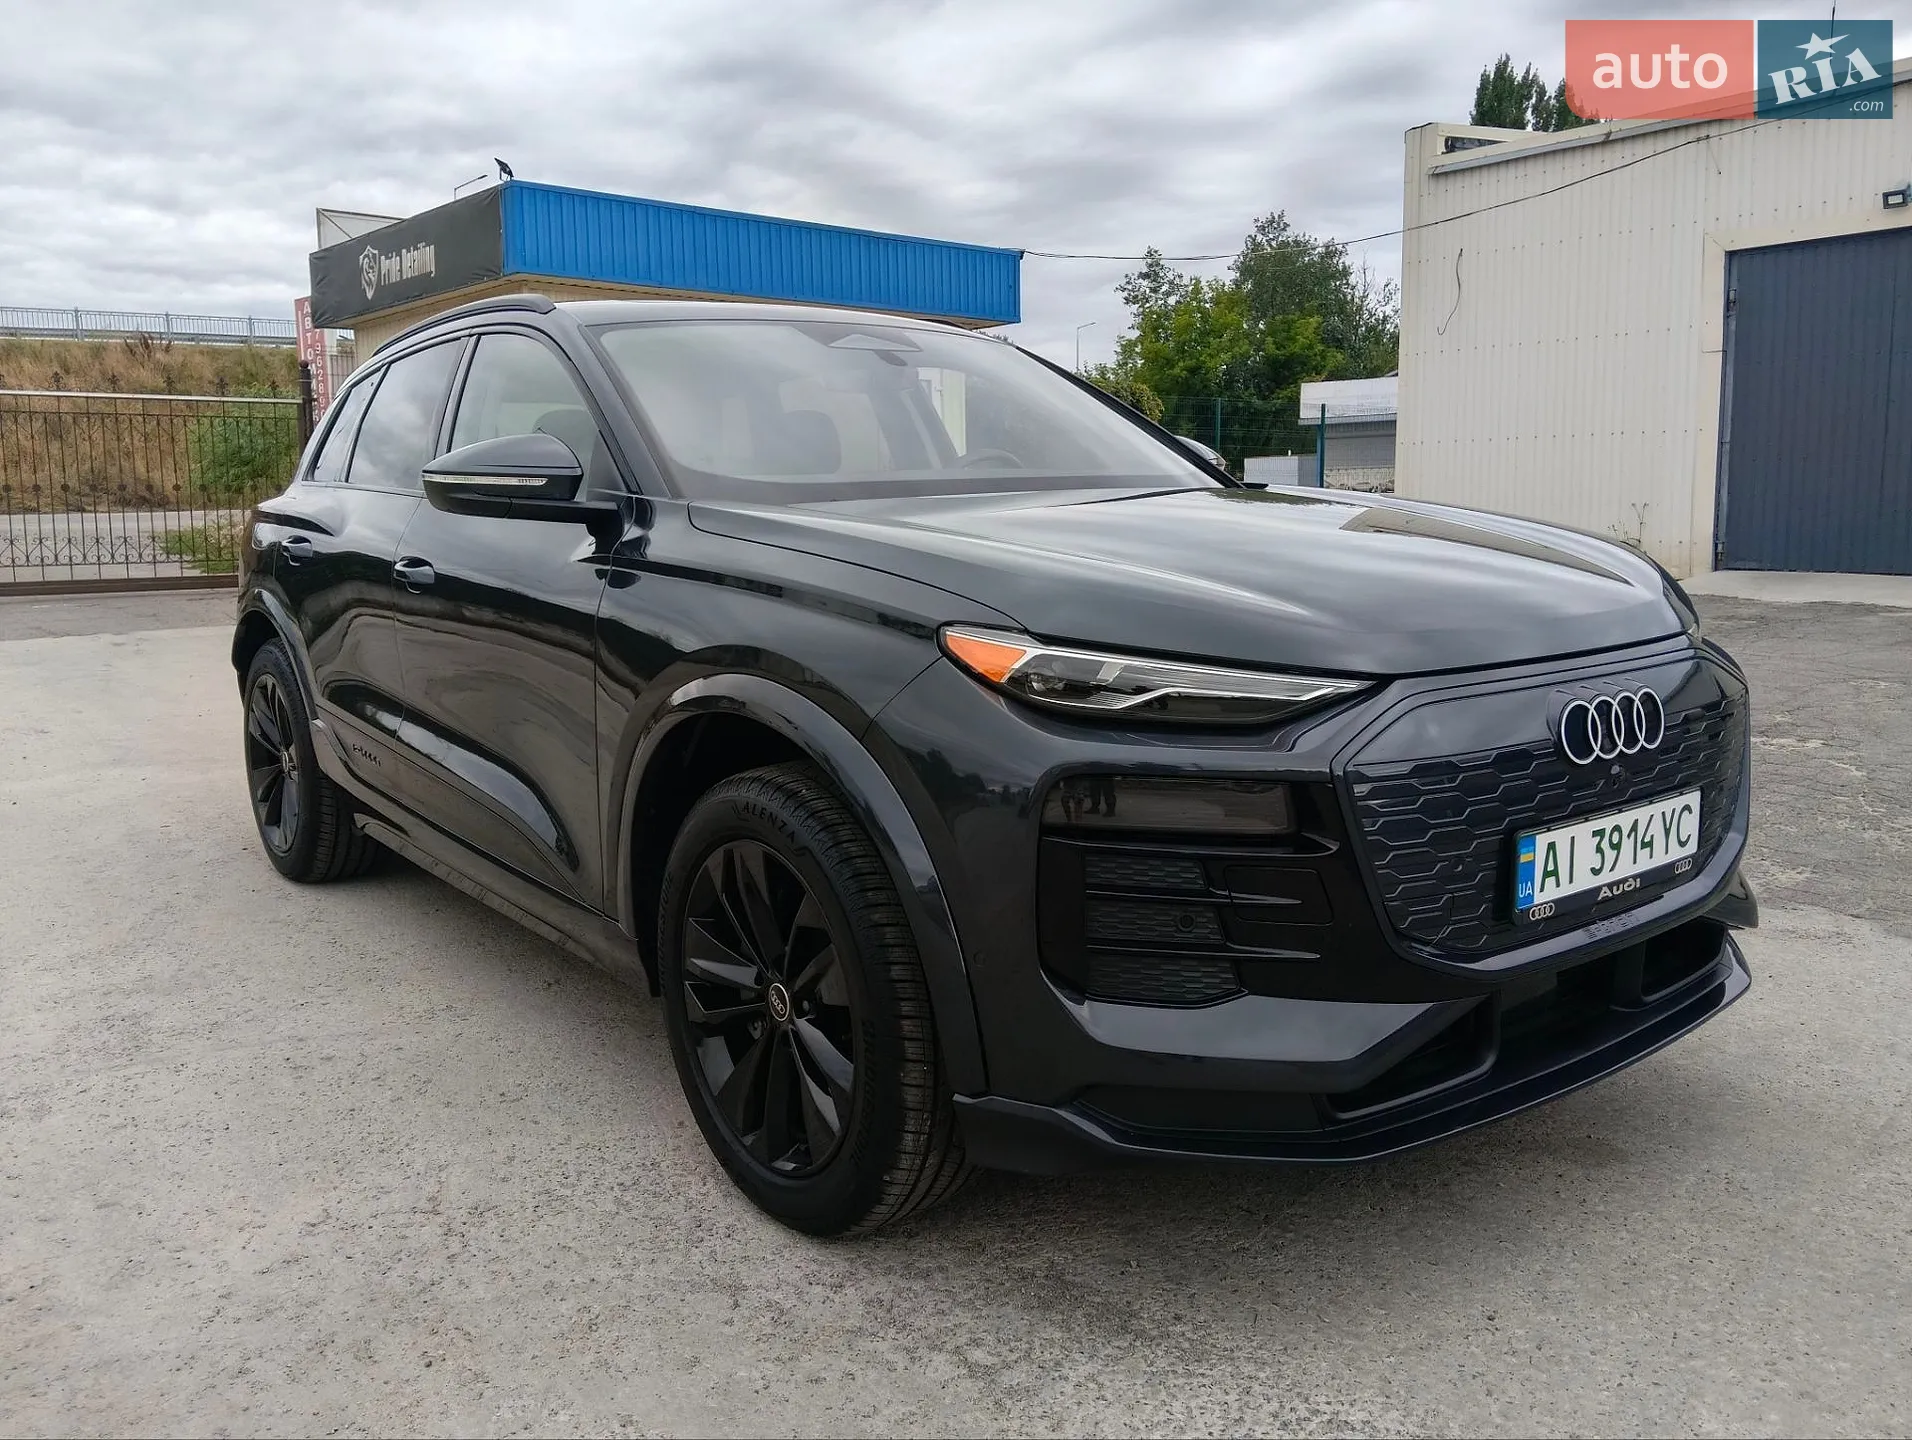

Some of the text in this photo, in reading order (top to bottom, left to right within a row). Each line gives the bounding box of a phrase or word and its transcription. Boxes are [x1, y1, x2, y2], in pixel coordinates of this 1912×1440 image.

[380, 242, 436, 286] Pride Detailing
[742, 801, 796, 843] ALENZA
[1539, 803, 1693, 893] AI 3914 YC
[1518, 881, 1533, 898] UA
[1597, 877, 1641, 900] Audi
